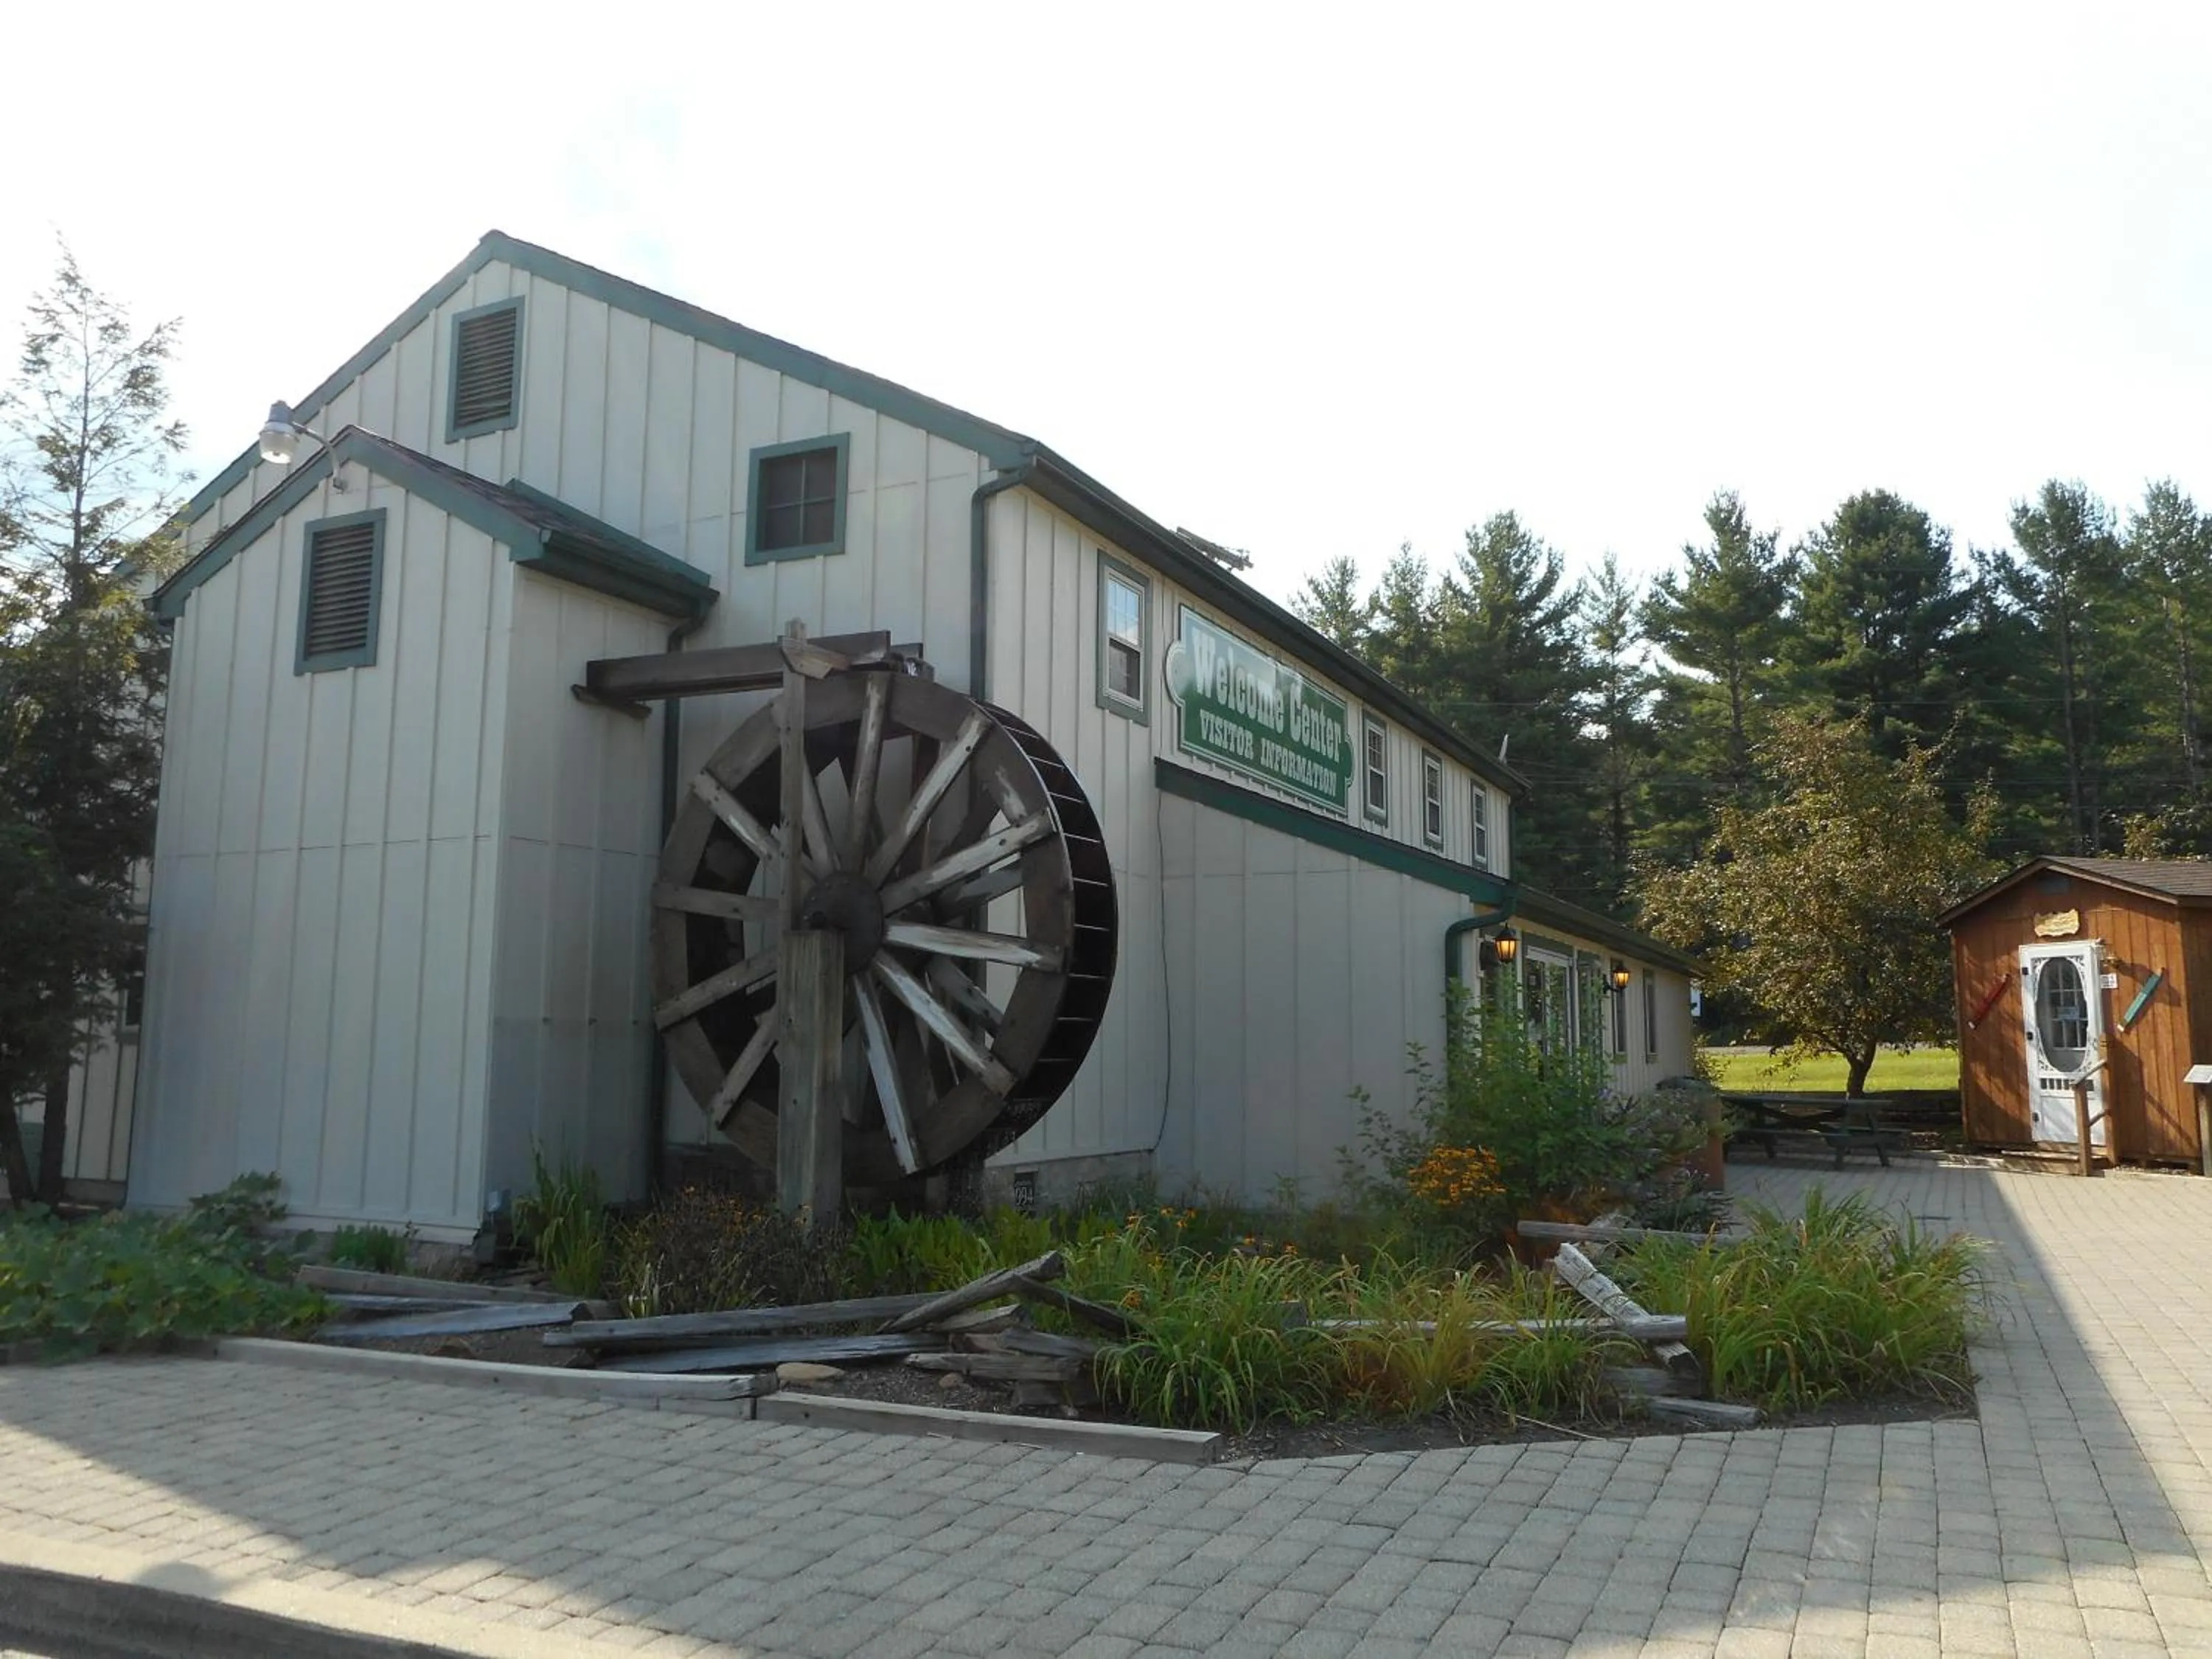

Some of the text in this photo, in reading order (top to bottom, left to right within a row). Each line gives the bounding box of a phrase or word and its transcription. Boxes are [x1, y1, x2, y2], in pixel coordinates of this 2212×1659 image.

[1192, 627, 1341, 763] Welcome Center
[1200, 709, 1337, 797] VISITOR INFORMATION
